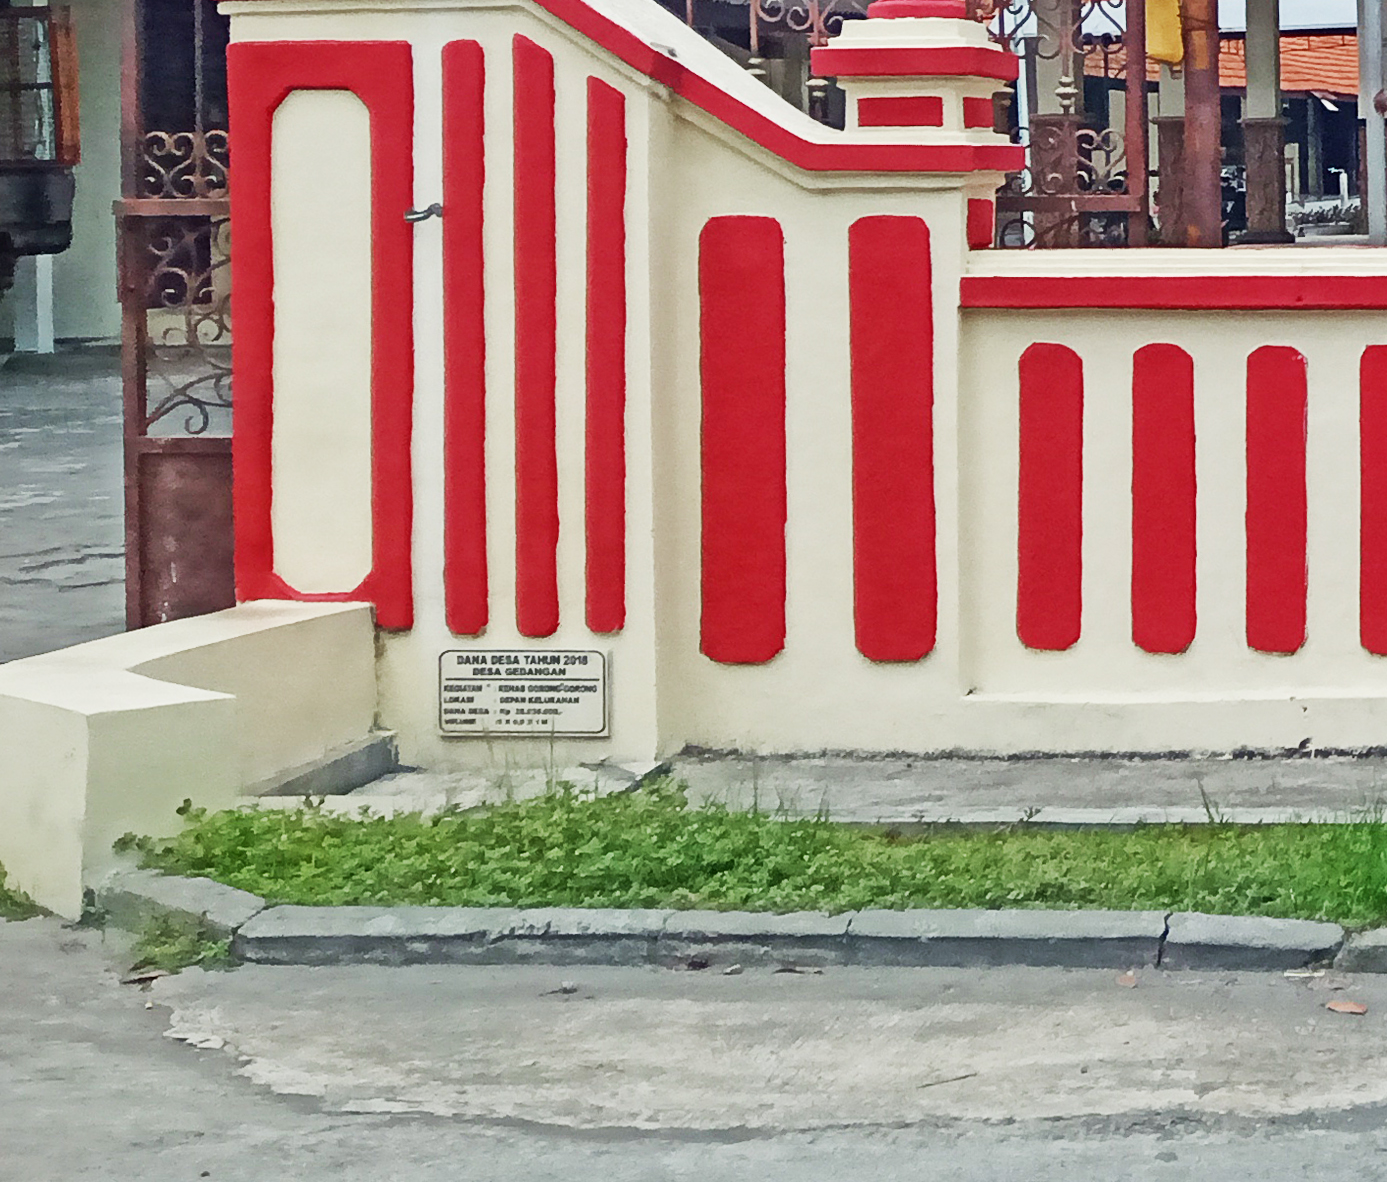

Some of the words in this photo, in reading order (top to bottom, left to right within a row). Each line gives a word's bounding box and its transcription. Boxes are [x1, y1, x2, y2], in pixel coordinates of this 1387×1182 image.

[456, 655, 488, 665] DANA
[490, 655, 520, 665] DESA
[523, 655, 561, 665] TAHUN
[472, 667, 502, 676] DESA
